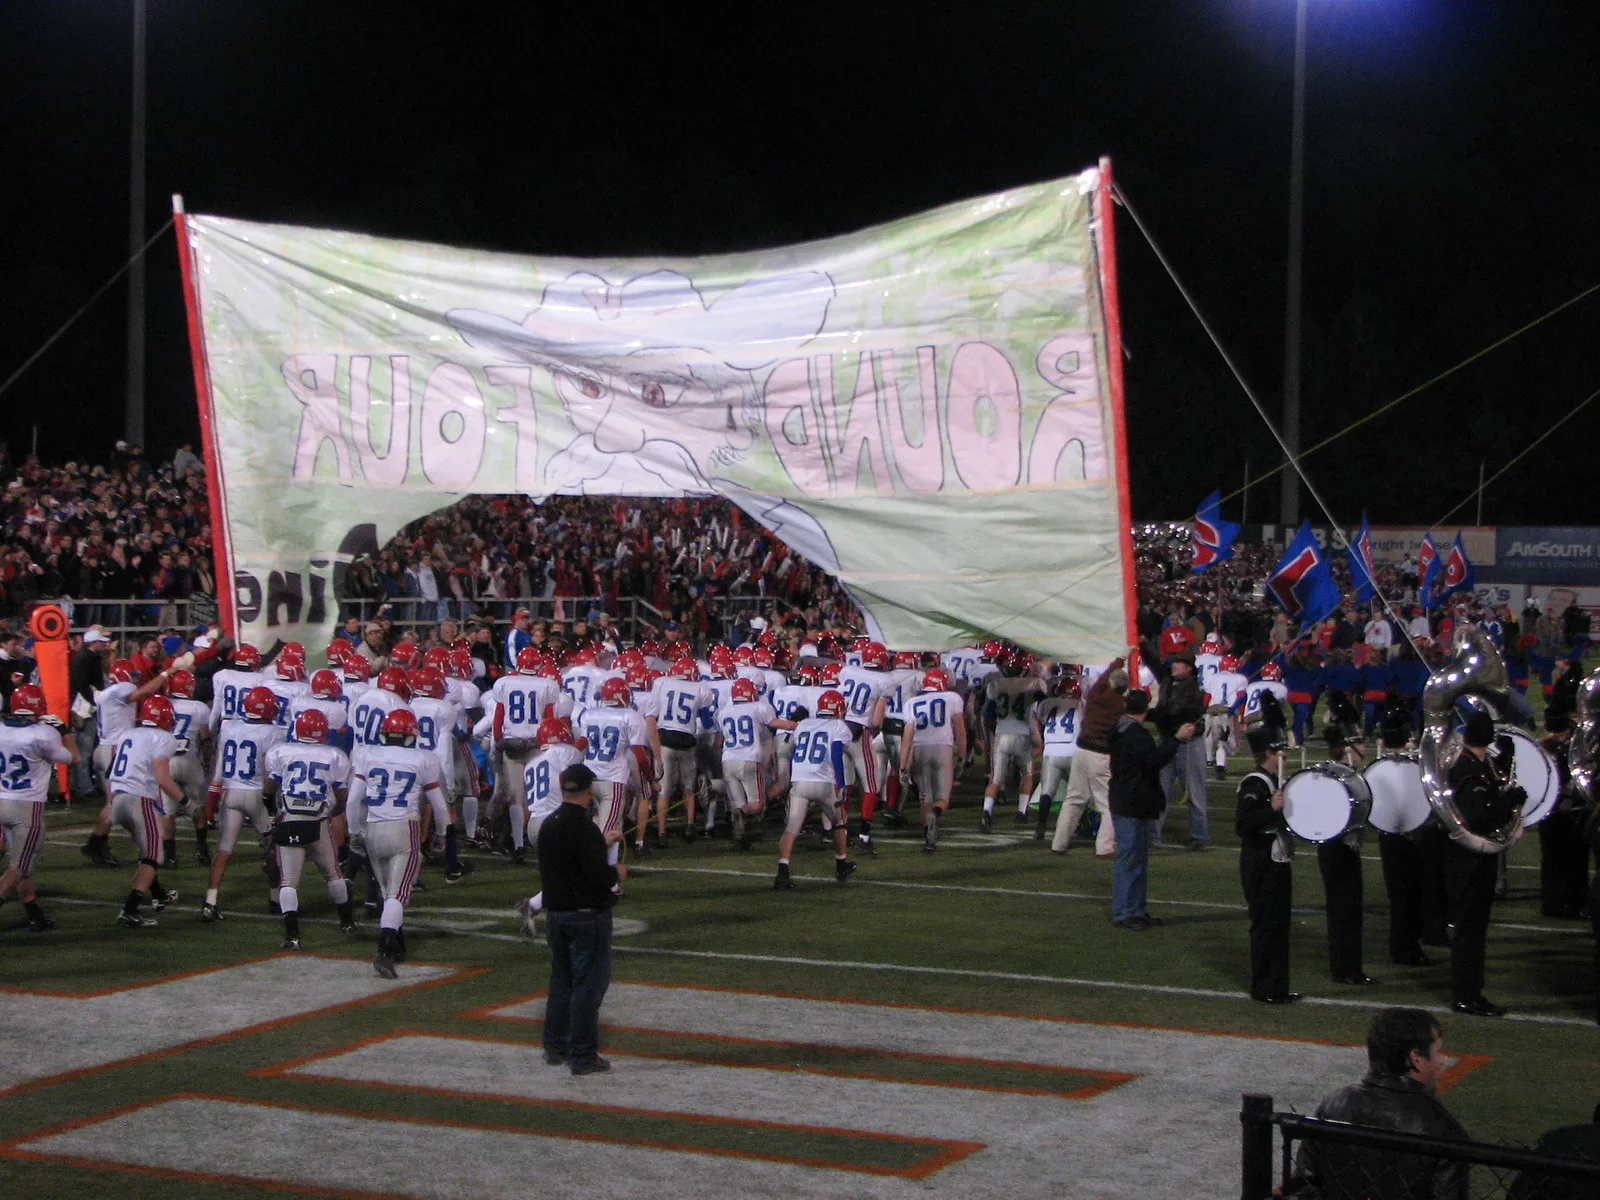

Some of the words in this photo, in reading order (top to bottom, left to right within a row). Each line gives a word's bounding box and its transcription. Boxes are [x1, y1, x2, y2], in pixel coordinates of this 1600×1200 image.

[355, 704, 386, 746] 90
[508, 690, 539, 725] 81
[663, 690, 696, 725] 15
[913, 698, 946, 731] 50
[1046, 707, 1076, 735] 44
[722, 715, 755, 749] 39
[793, 731, 829, 765] 96
[113, 738, 133, 777] 6
[221, 739, 257, 780] 83
[286, 760, 331, 801] 25
[366, 767, 418, 808] 37
[524, 759, 551, 807] 28
